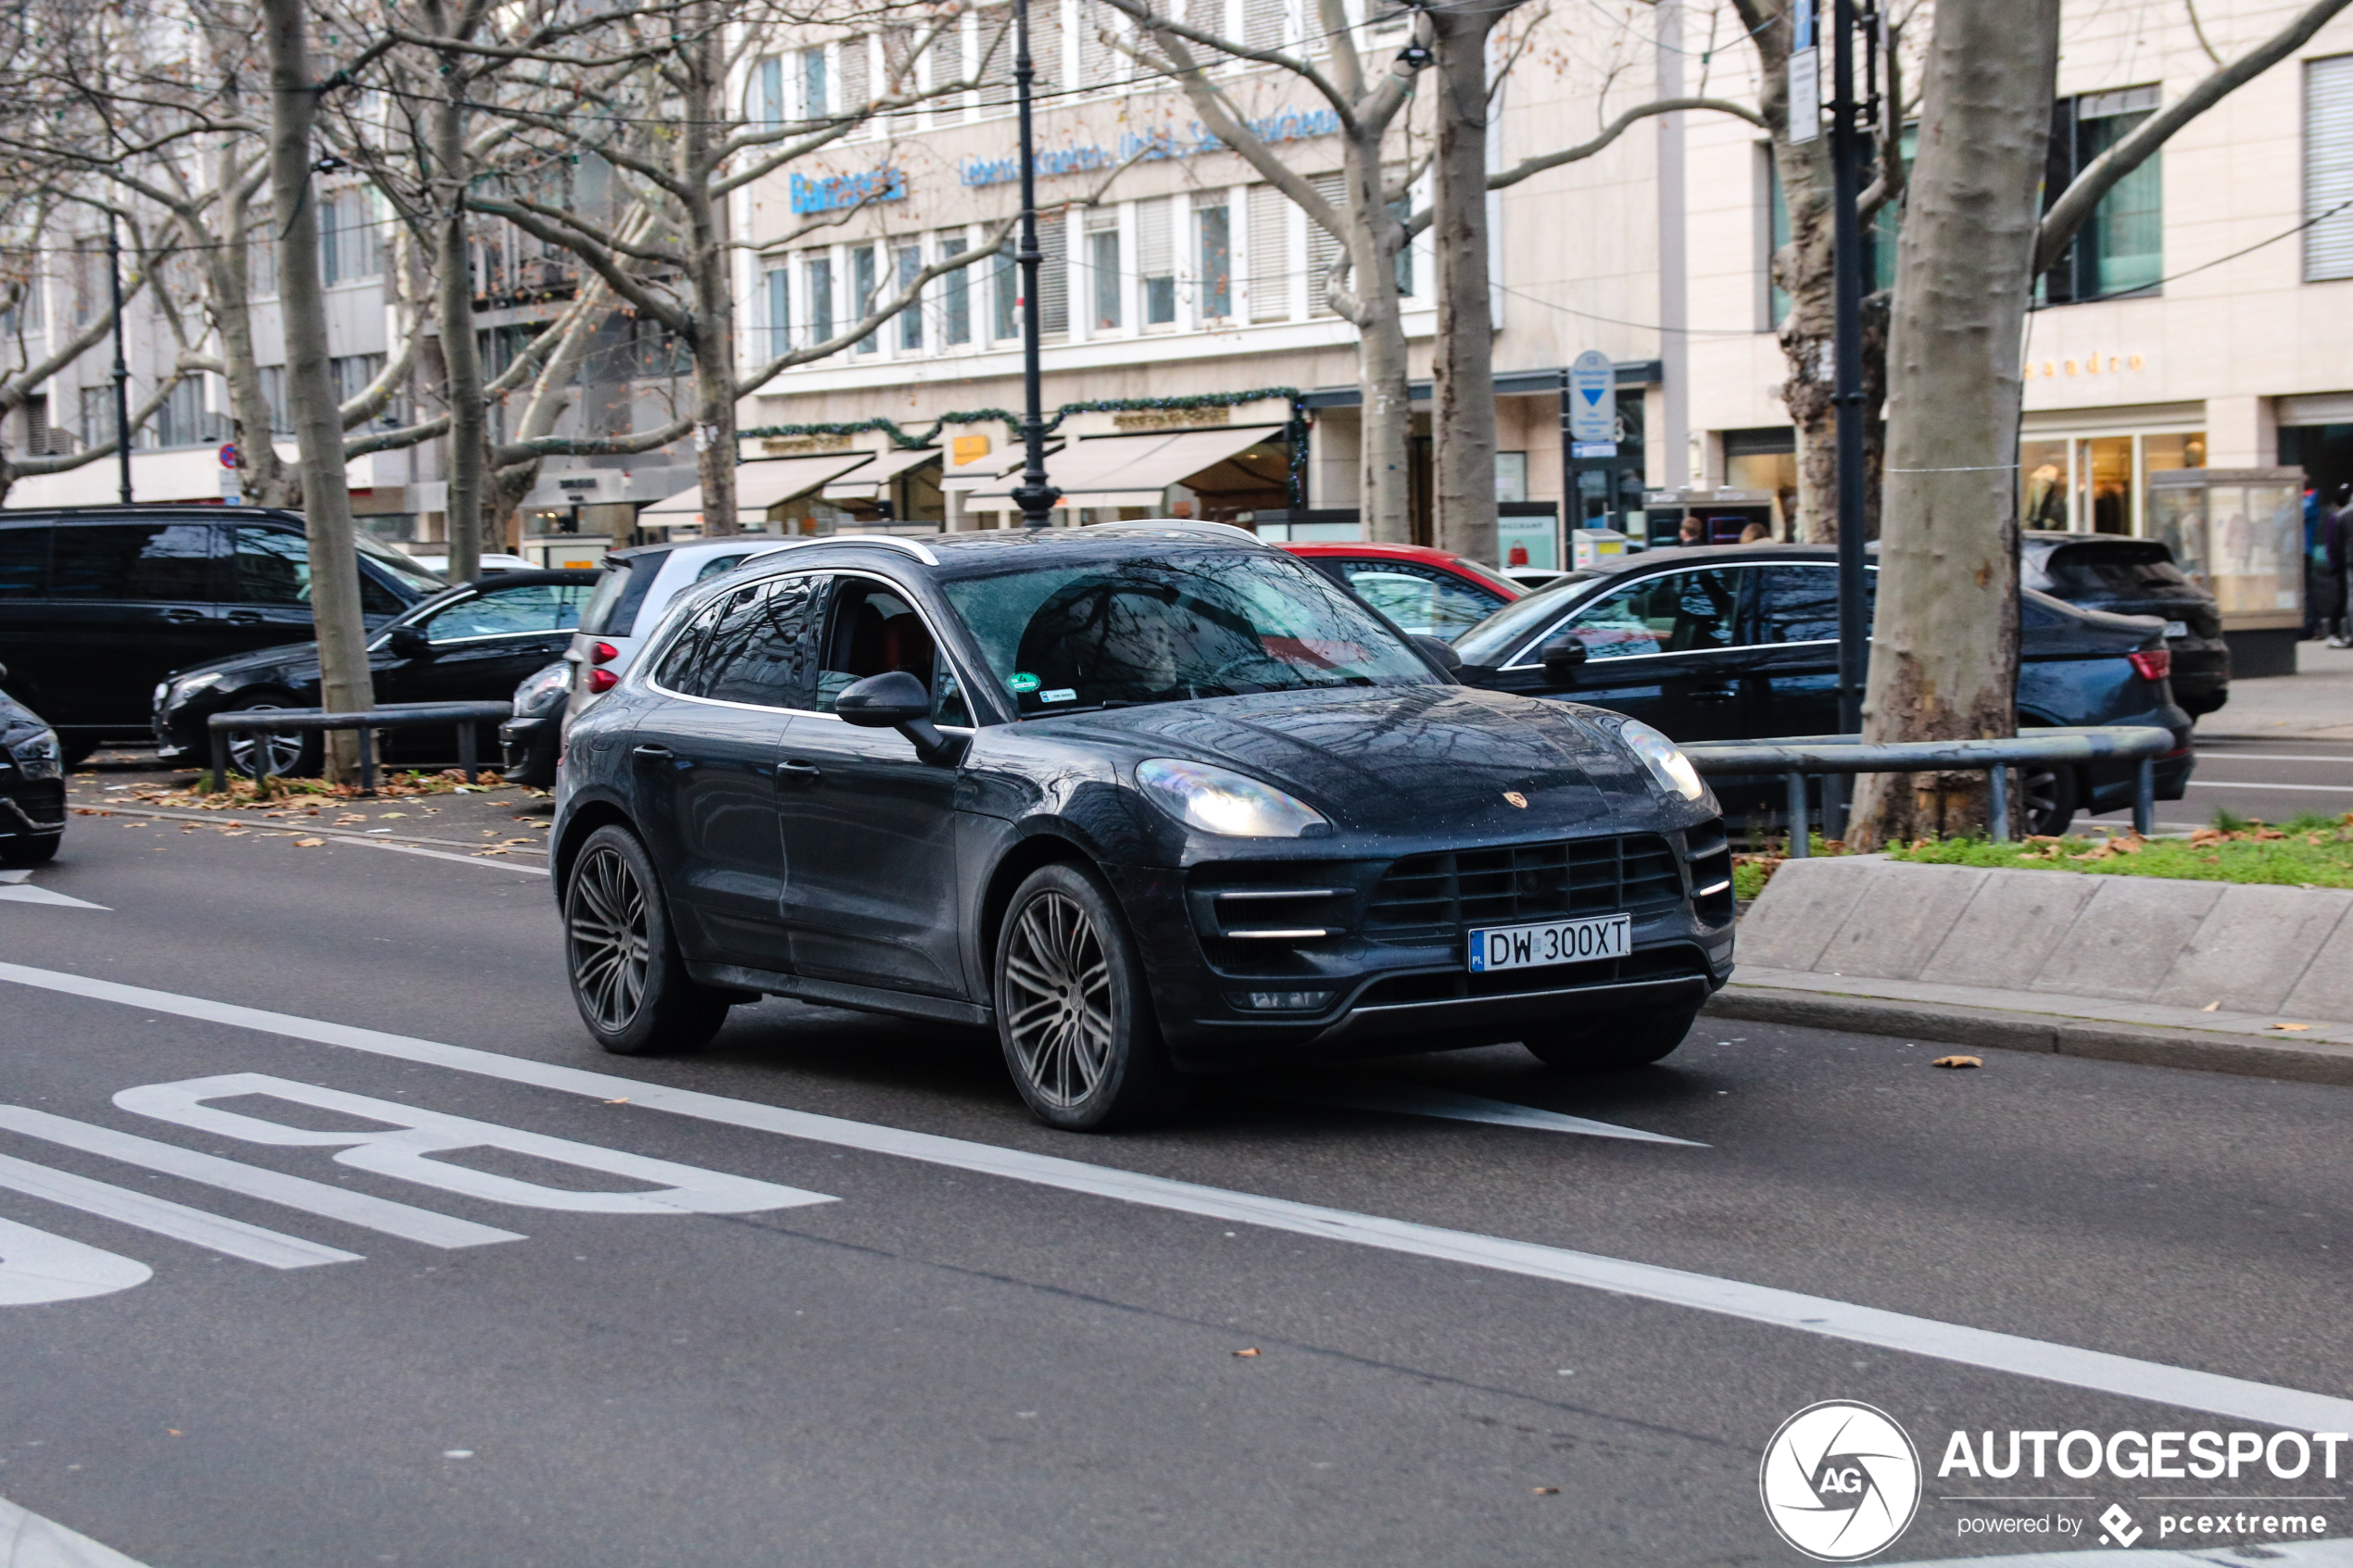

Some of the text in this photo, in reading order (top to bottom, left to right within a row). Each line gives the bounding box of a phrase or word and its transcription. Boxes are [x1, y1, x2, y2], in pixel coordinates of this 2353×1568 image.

[2023, 349, 2145, 380] sandro
[1490, 920, 1627, 966] DW 300XT
[1472, 956, 1483, 965] PL
